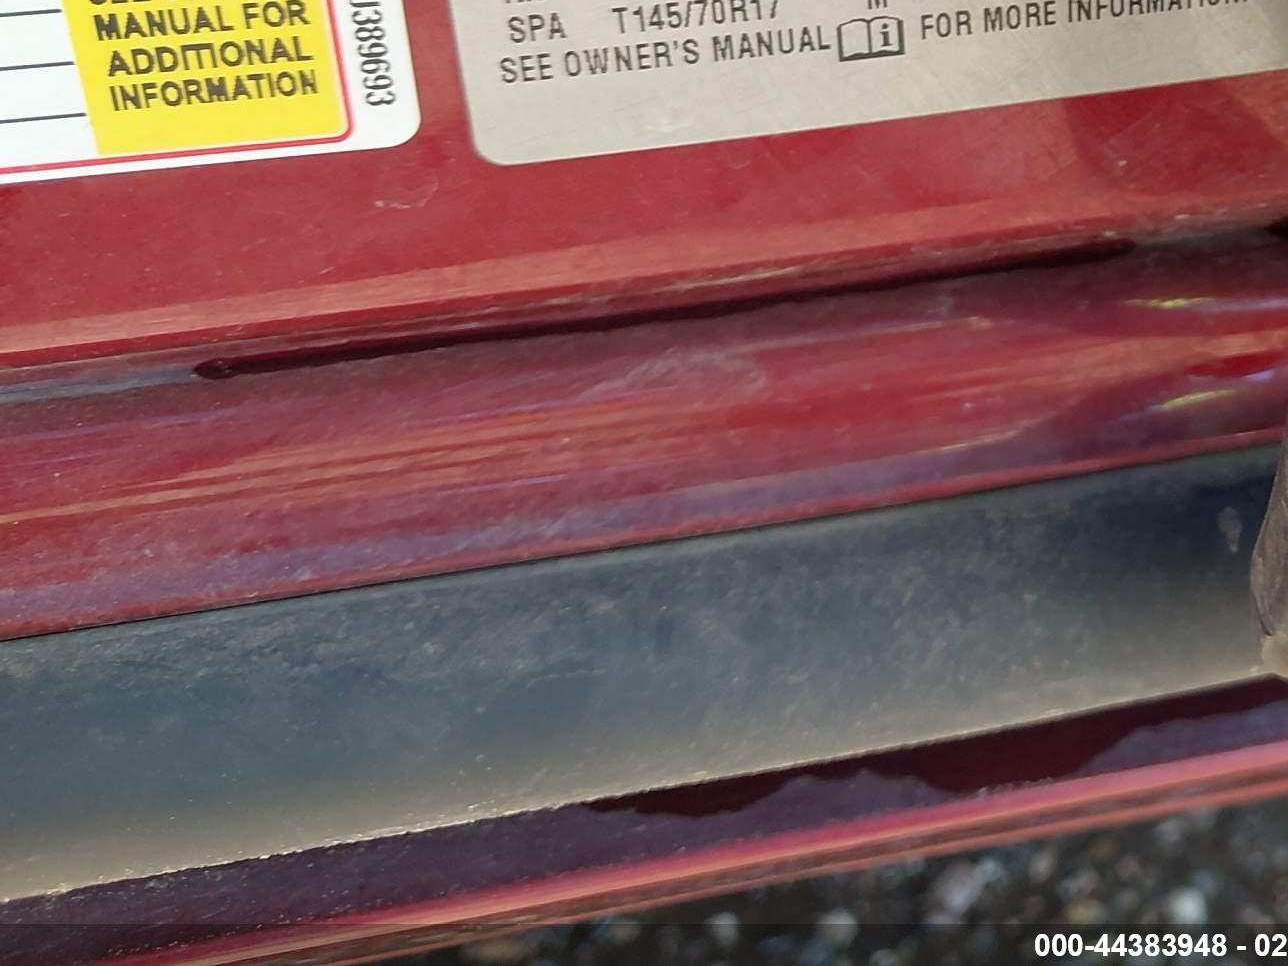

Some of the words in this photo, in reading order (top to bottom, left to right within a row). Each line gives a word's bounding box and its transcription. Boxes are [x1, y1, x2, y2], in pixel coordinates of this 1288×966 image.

[93, 6, 234, 41] MANUAL
[242, 0, 310, 29] FOR
[508, 13, 566, 43] SPA
[108, 36, 313, 77] ADDITIONAL
[500, 54, 553, 83] SEE
[564, 39, 699, 76] OWNER'S
[712, 26, 831, 61] MANUAL
[921, 10, 972, 39] FOR
[984, 0, 1056, 32] MORE
[110, 70, 318, 111] INFORMATION
